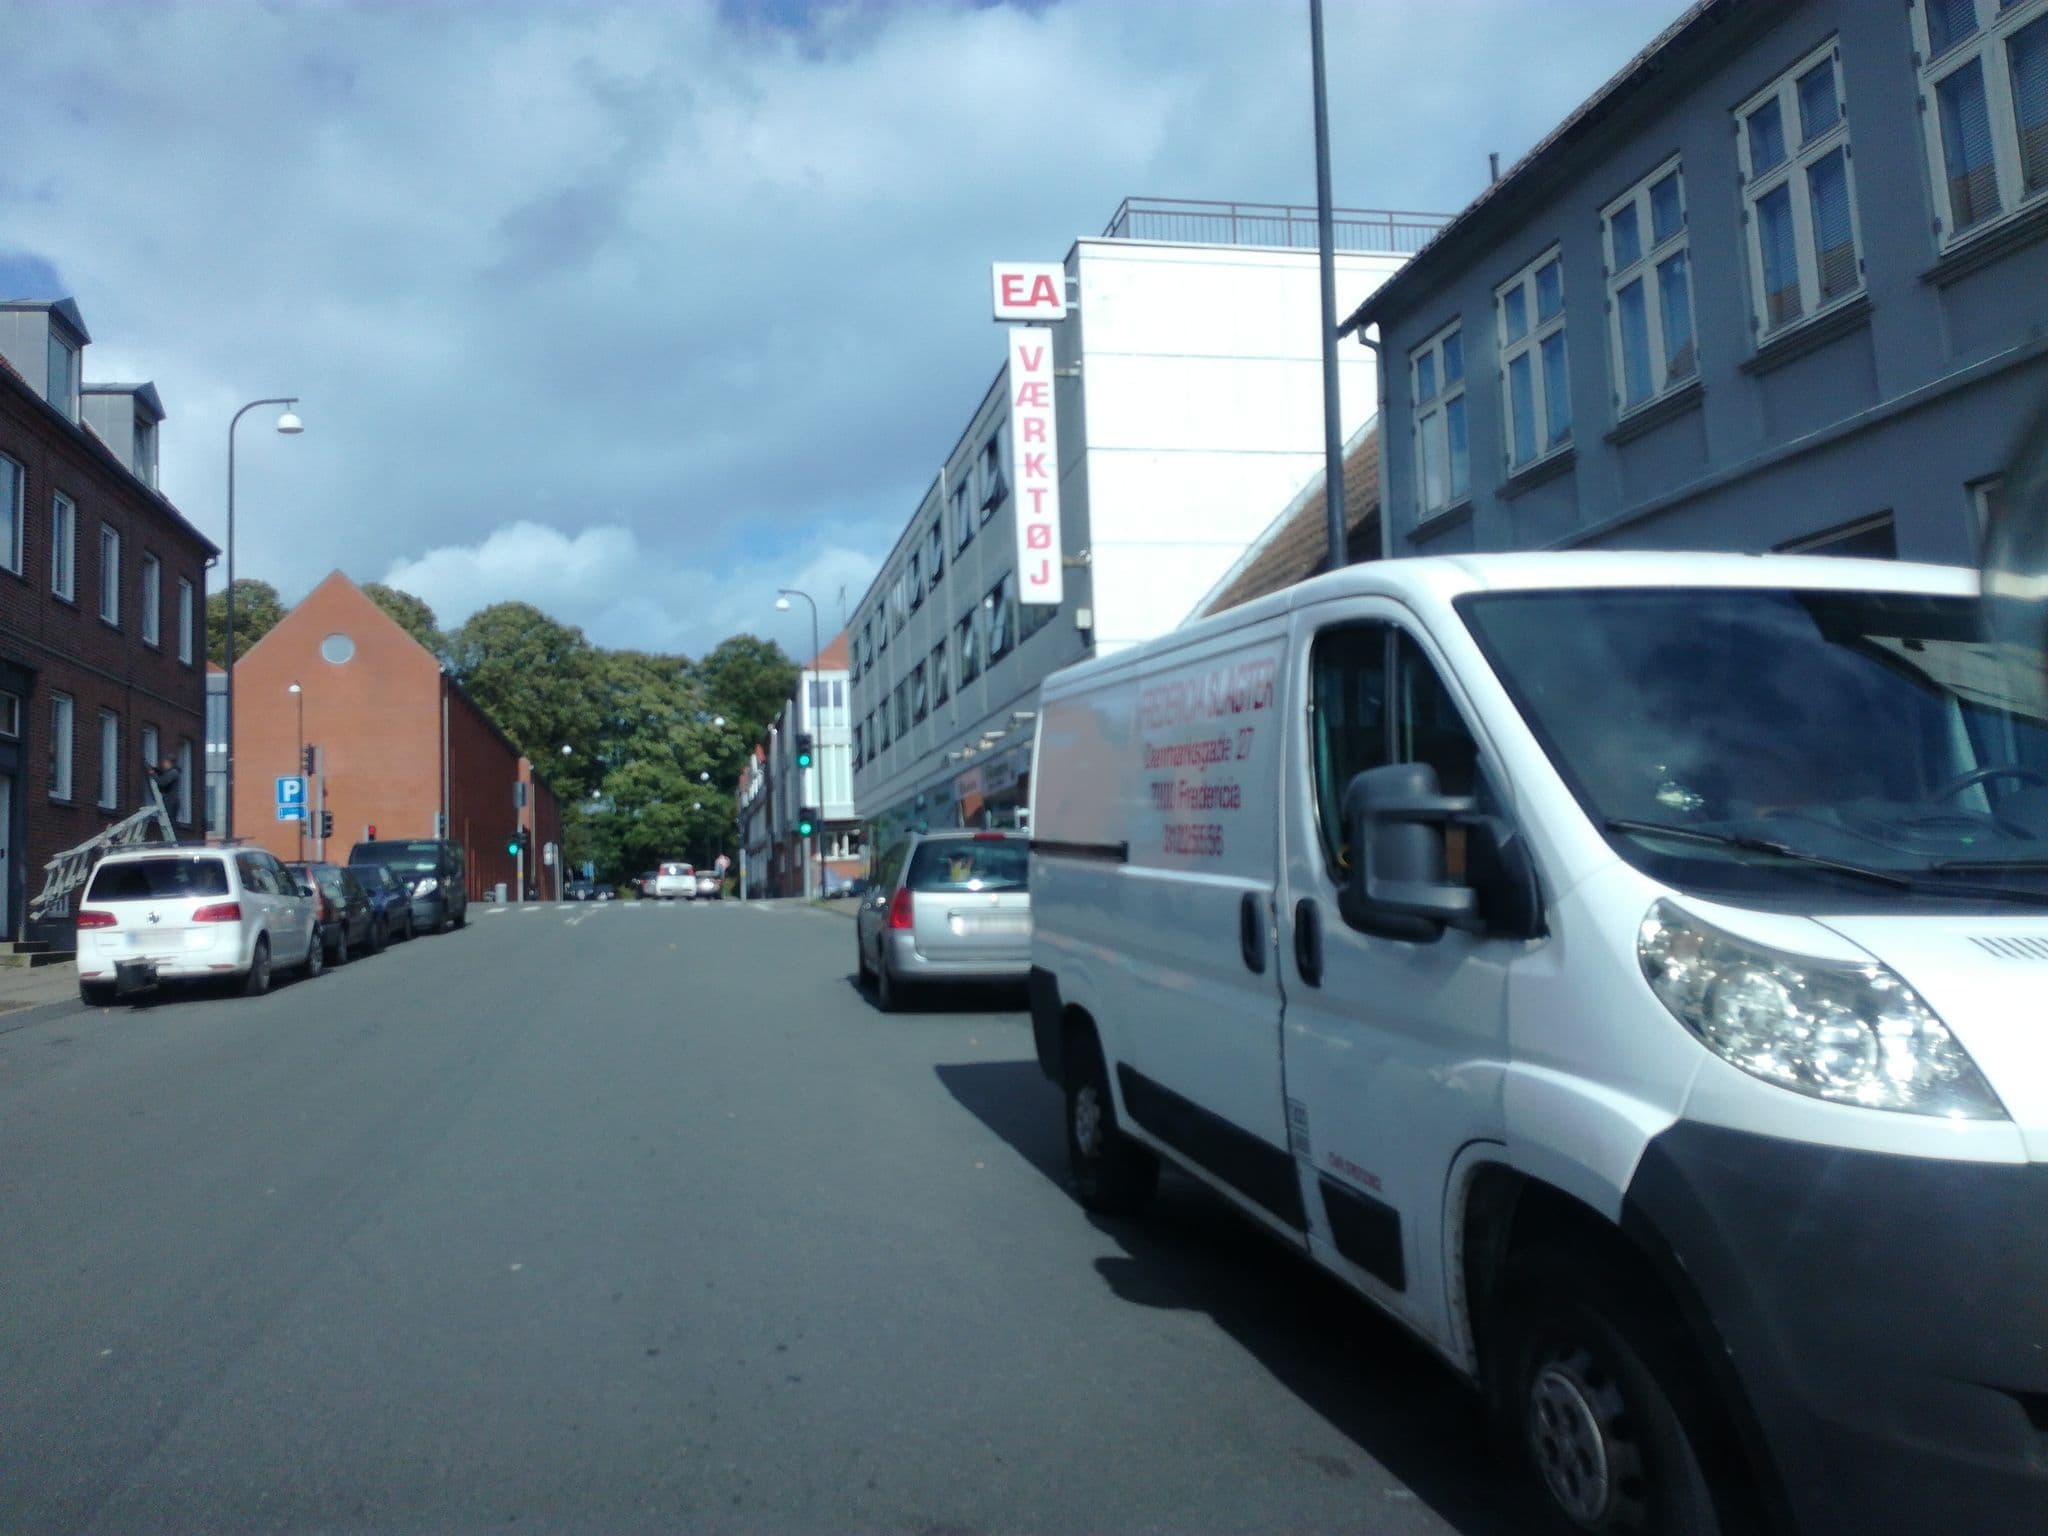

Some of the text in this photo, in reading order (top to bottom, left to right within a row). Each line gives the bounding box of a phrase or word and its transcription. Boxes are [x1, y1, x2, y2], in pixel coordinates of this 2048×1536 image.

[1001, 274, 1061, 307] EA
[1015, 346, 1052, 586] VÆRKTØJ
[283, 780, 301, 801] P
